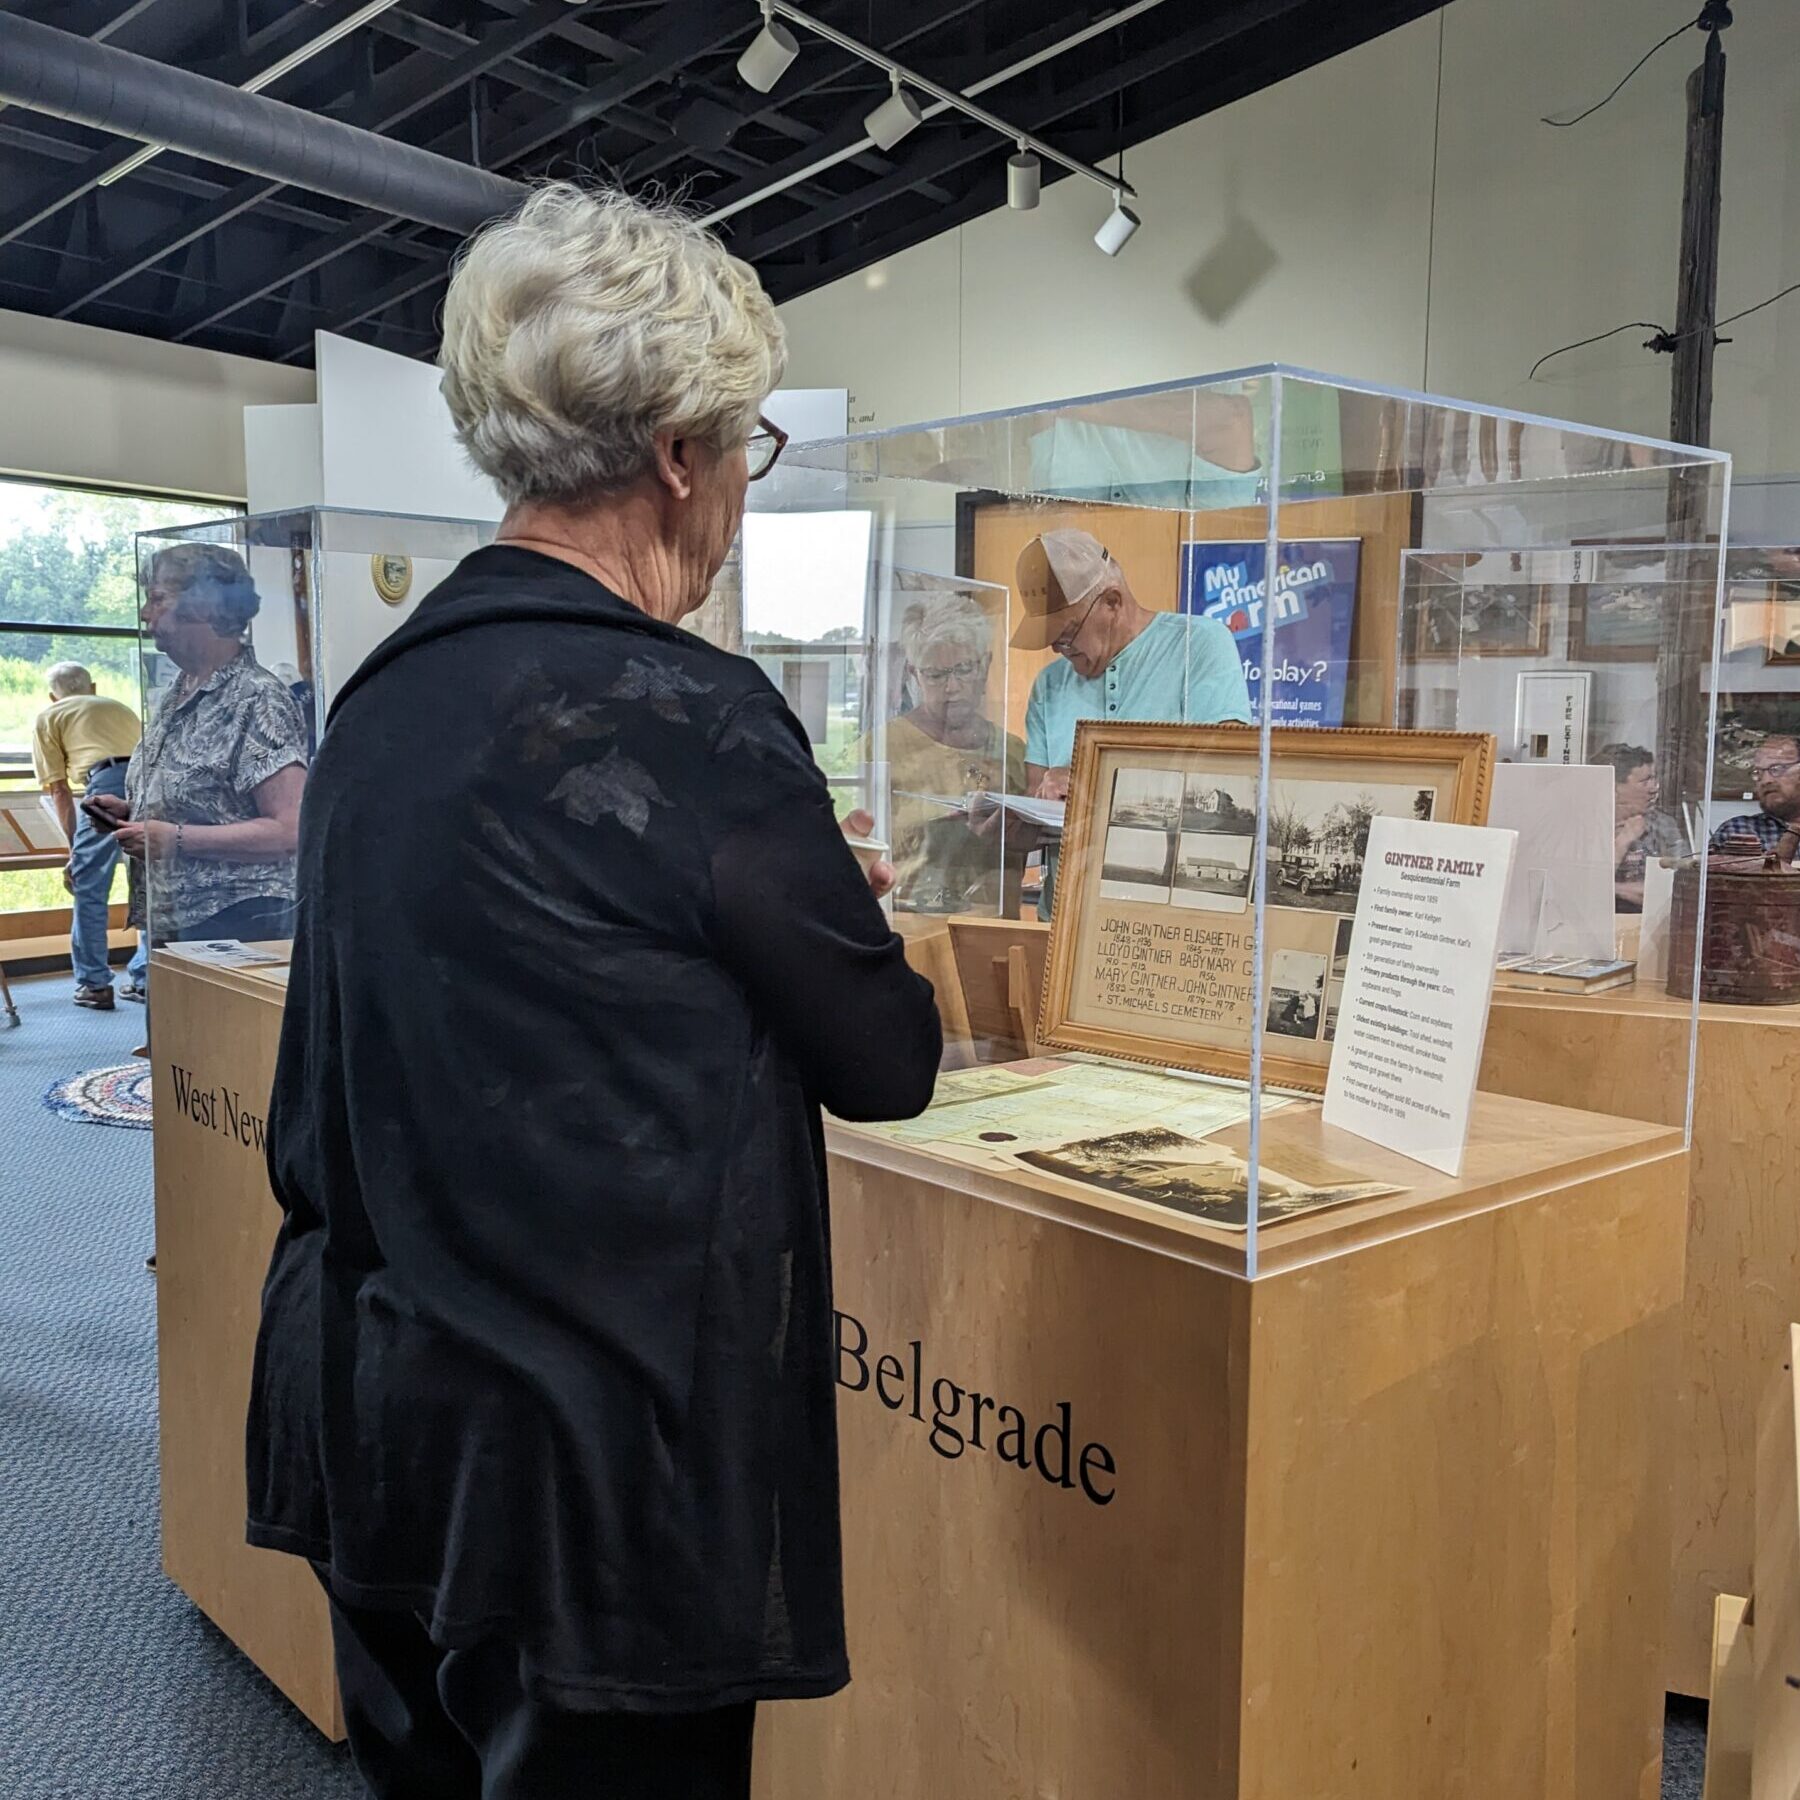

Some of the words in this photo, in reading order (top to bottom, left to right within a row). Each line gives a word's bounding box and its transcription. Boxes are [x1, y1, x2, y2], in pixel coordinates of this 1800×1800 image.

[1206, 566, 1239, 592] My
[1243, 659, 1260, 680] to
[1300, 701, 1321, 713] games
[1385, 851, 1433, 871] GINTNER
[1436, 858, 1485, 877] FAMILY
[1400, 872, 1445, 885] Sesquicentennial
[1446, 878, 1460, 888] Farm
[1377, 886, 1390, 897] Family
[1414, 893, 1425, 901] since
[1374, 904, 1384, 912] First
[1385, 906, 1397, 916] family
[1415, 911, 1423, 919] Karl
[1101, 919, 1130, 934] JOHN
[1132, 921, 1180, 940] GINTNER
[1184, 928, 1239, 948] ELISABETH
[1371, 921, 1387, 931] Present
[1098, 942, 1130, 958] LLOYD
[1132, 946, 1172, 964] GINTNER
[1180, 952, 1206, 969] BABY
[1207, 957, 1236, 973] MARY
[1402, 960, 1415, 971] family
[1095, 966, 1128, 982] MARY
[1131, 970, 1176, 990] GINTNER
[1178, 980, 1207, 994] JOHN
[1364, 966, 1380, 977] Primary
[1381, 970, 1399, 981] products
[1400, 975, 1417, 986] through
[1107, 995, 1121, 1005] ST.
[1171, 1004, 1223, 1020] CEMETERY
[1356, 1014, 1370, 1024] Oldest
[1359, 997, 1374, 1007] Current
[1421, 1015, 1430, 1023] and
[171, 1064, 217, 1130] West
[832, 1309, 1116, 1506] Belgrade
